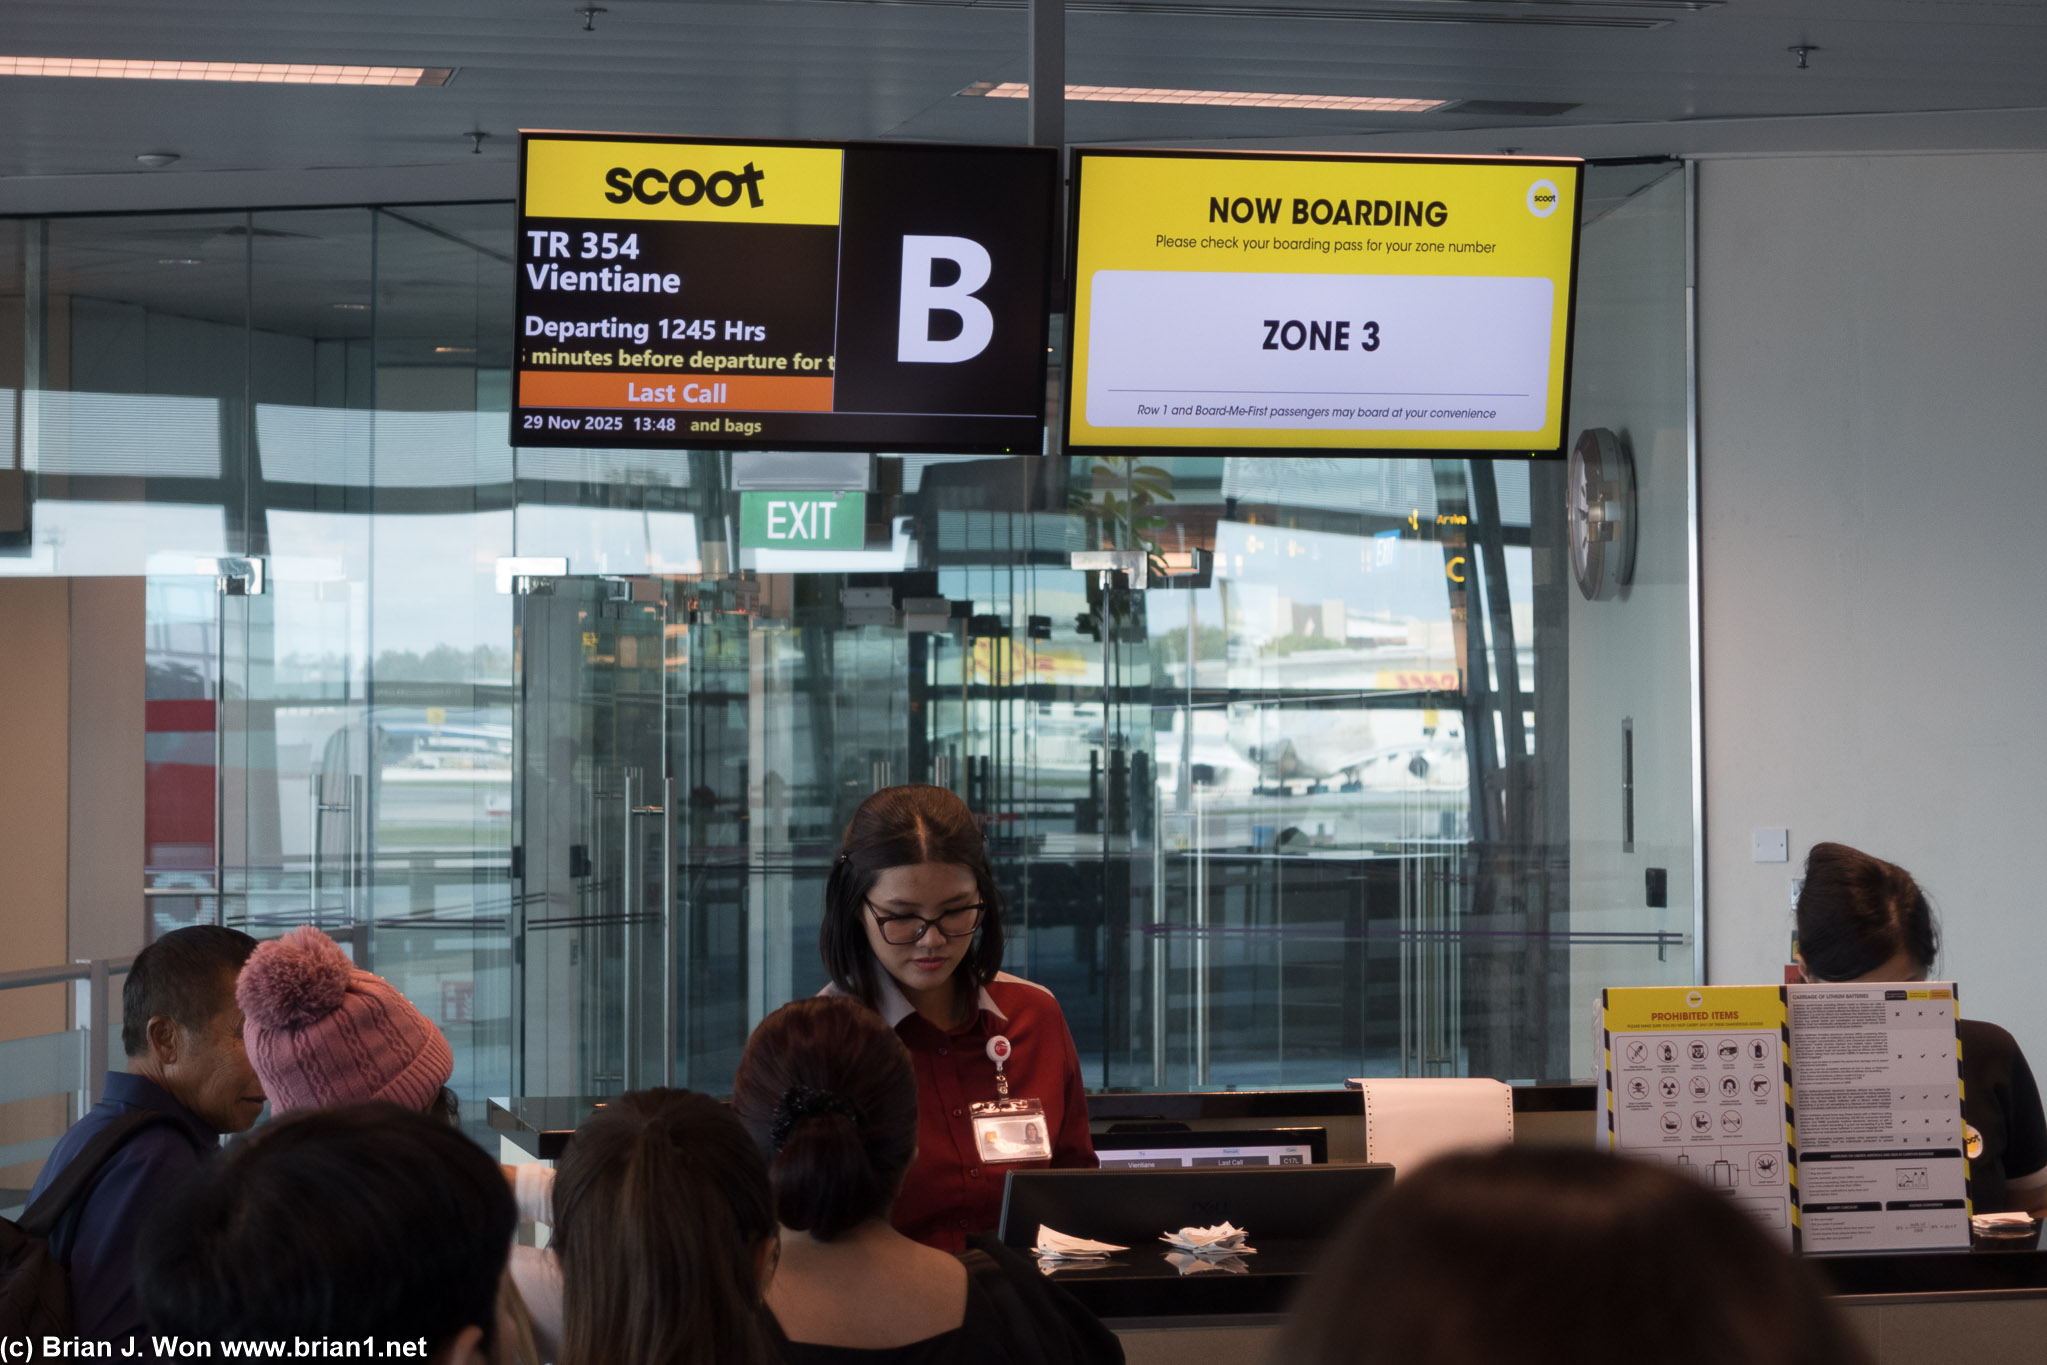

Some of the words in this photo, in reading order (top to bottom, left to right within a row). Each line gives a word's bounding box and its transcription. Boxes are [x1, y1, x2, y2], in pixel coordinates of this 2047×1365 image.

[605, 162, 764, 208] scoot
[1534, 194, 1556, 204] scoot
[1210, 197, 1282, 223] NOW
[1292, 199, 1447, 227] BOARDING
[528, 231, 570, 257] TR
[581, 232, 639, 259] 354
[1156, 235, 1197, 248] Please
[1201, 236, 1238, 249] check
[1243, 238, 1270, 252] your
[1273, 237, 1330, 253] boarding
[1334, 241, 1362, 253] pass
[1366, 239, 1382, 251] for
[1386, 242, 1412, 254] your
[1415, 242, 1444, 253] zone
[1448, 241, 1496, 253] number
[527, 263, 680, 293] Vientiane
[898, 235, 993, 363] B
[526, 316, 648, 344] Departing
[659, 319, 715, 340] 1245
[725, 321, 765, 341] Hrs
[1263, 320, 1350, 350] ZONE
[1362, 321, 1380, 351] 3
[532, 349, 612, 367] minutes
[619, 350, 684, 368] before
[689, 352, 787, 371] departure
[792, 353, 823, 370] for
[629, 382, 675, 402] Last
[683, 383, 726, 403] Call
[524, 415, 543, 428] 29
[549, 416, 580, 429] Nov
[585, 417, 622, 430] 2025
[634, 417, 675, 431] 13:48
[1137, 405, 1160, 416] Row
[1163, 406, 1167, 416] 1
[1171, 406, 1192, 416] and
[1195, 406, 1267, 418] Board-Me-First
[1270, 407, 1329, 420] passengers
[1333, 409, 1355, 421] may
[1357, 407, 1388, 418] board
[1391, 409, 1402, 418] at
[1405, 410, 1427, 421] your
[1430, 409, 1496, 419] convenience
[691, 418, 719, 431] and
[725, 418, 761, 435] bags
[768, 501, 837, 539] EXIT
[1652, 1012, 1708, 1021] PROHIBITED
[1712, 1012, 1738, 1020] ITEMS
